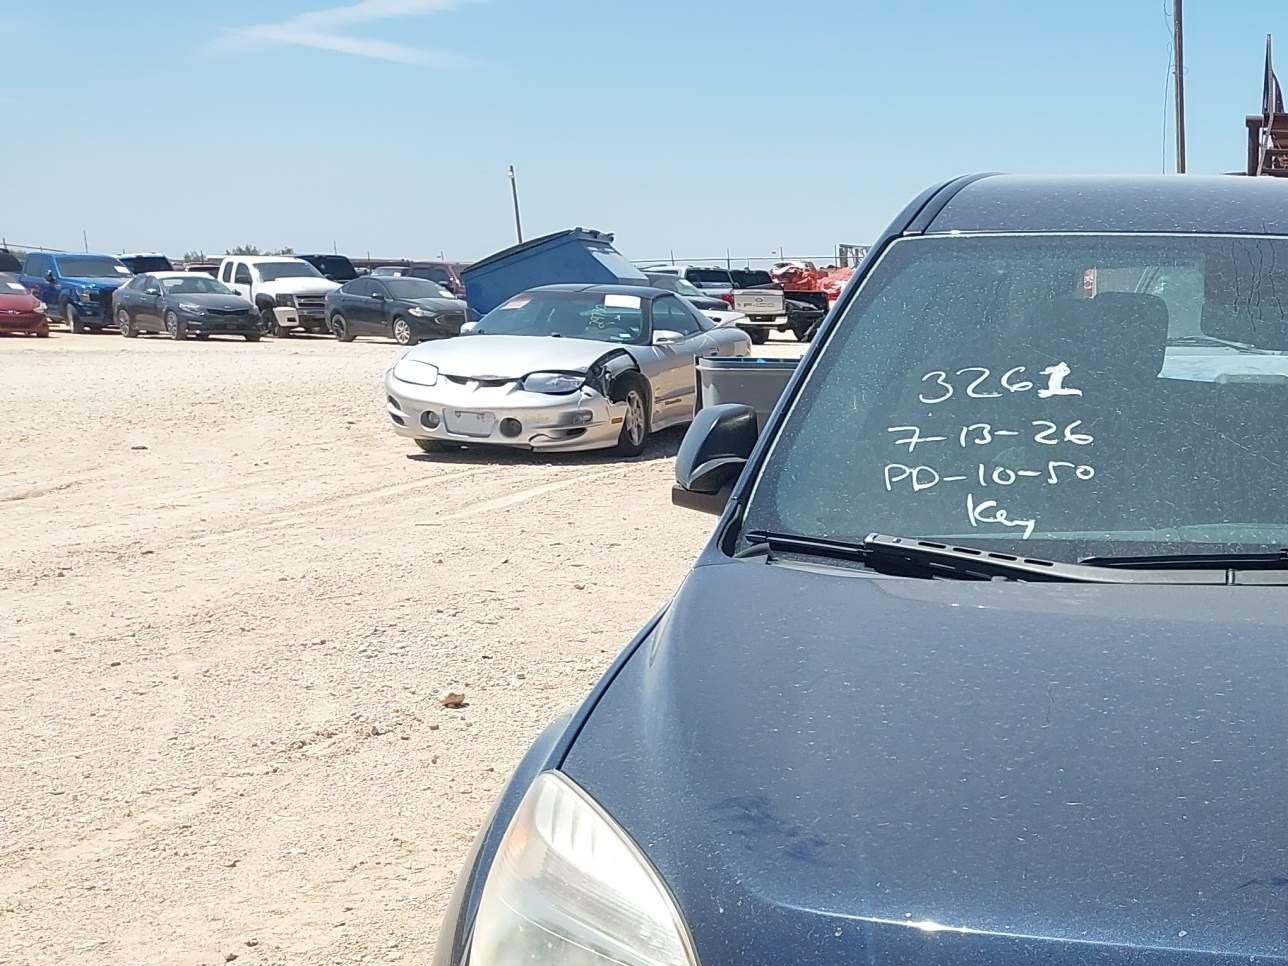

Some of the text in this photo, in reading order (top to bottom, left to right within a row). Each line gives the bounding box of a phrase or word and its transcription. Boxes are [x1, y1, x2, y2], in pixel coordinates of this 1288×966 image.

[919, 361, 1083, 404] 3261
[887, 419, 1095, 453] 7-13-26
[884, 460, 1096, 492] PD-10-50
[966, 492, 1036, 541] Key
